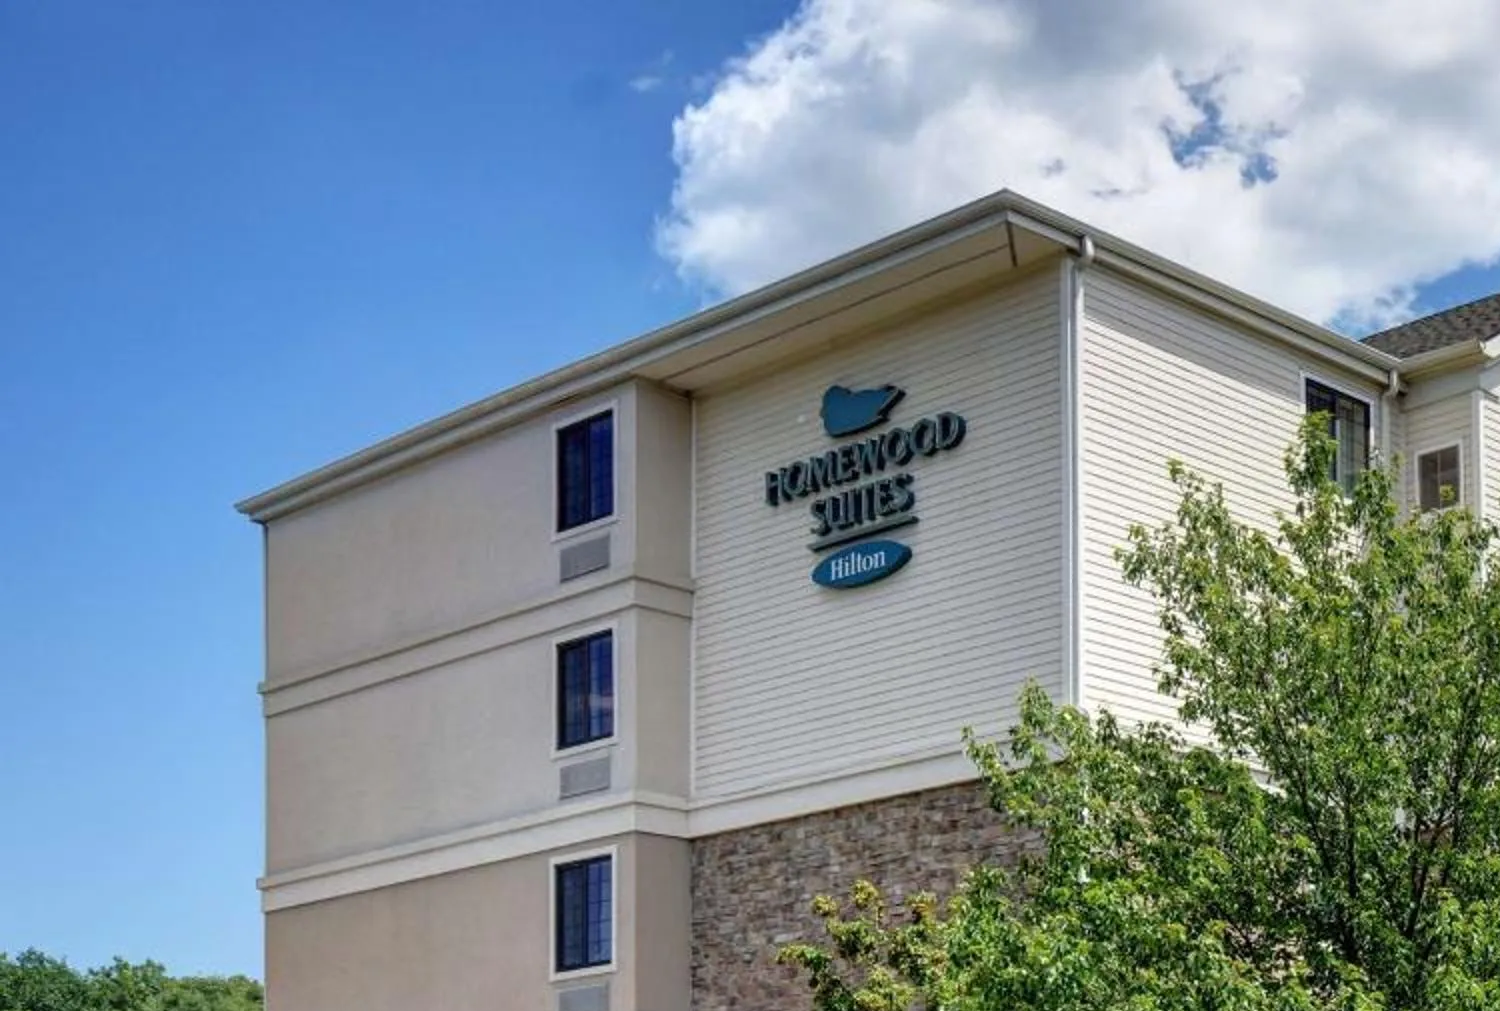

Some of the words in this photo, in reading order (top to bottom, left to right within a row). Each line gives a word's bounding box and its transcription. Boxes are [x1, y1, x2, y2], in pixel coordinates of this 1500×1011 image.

[765, 412, 967, 506] HOMEWOOD
[810, 473, 915, 536] SUITES
[831, 551, 885, 581] Hilton
